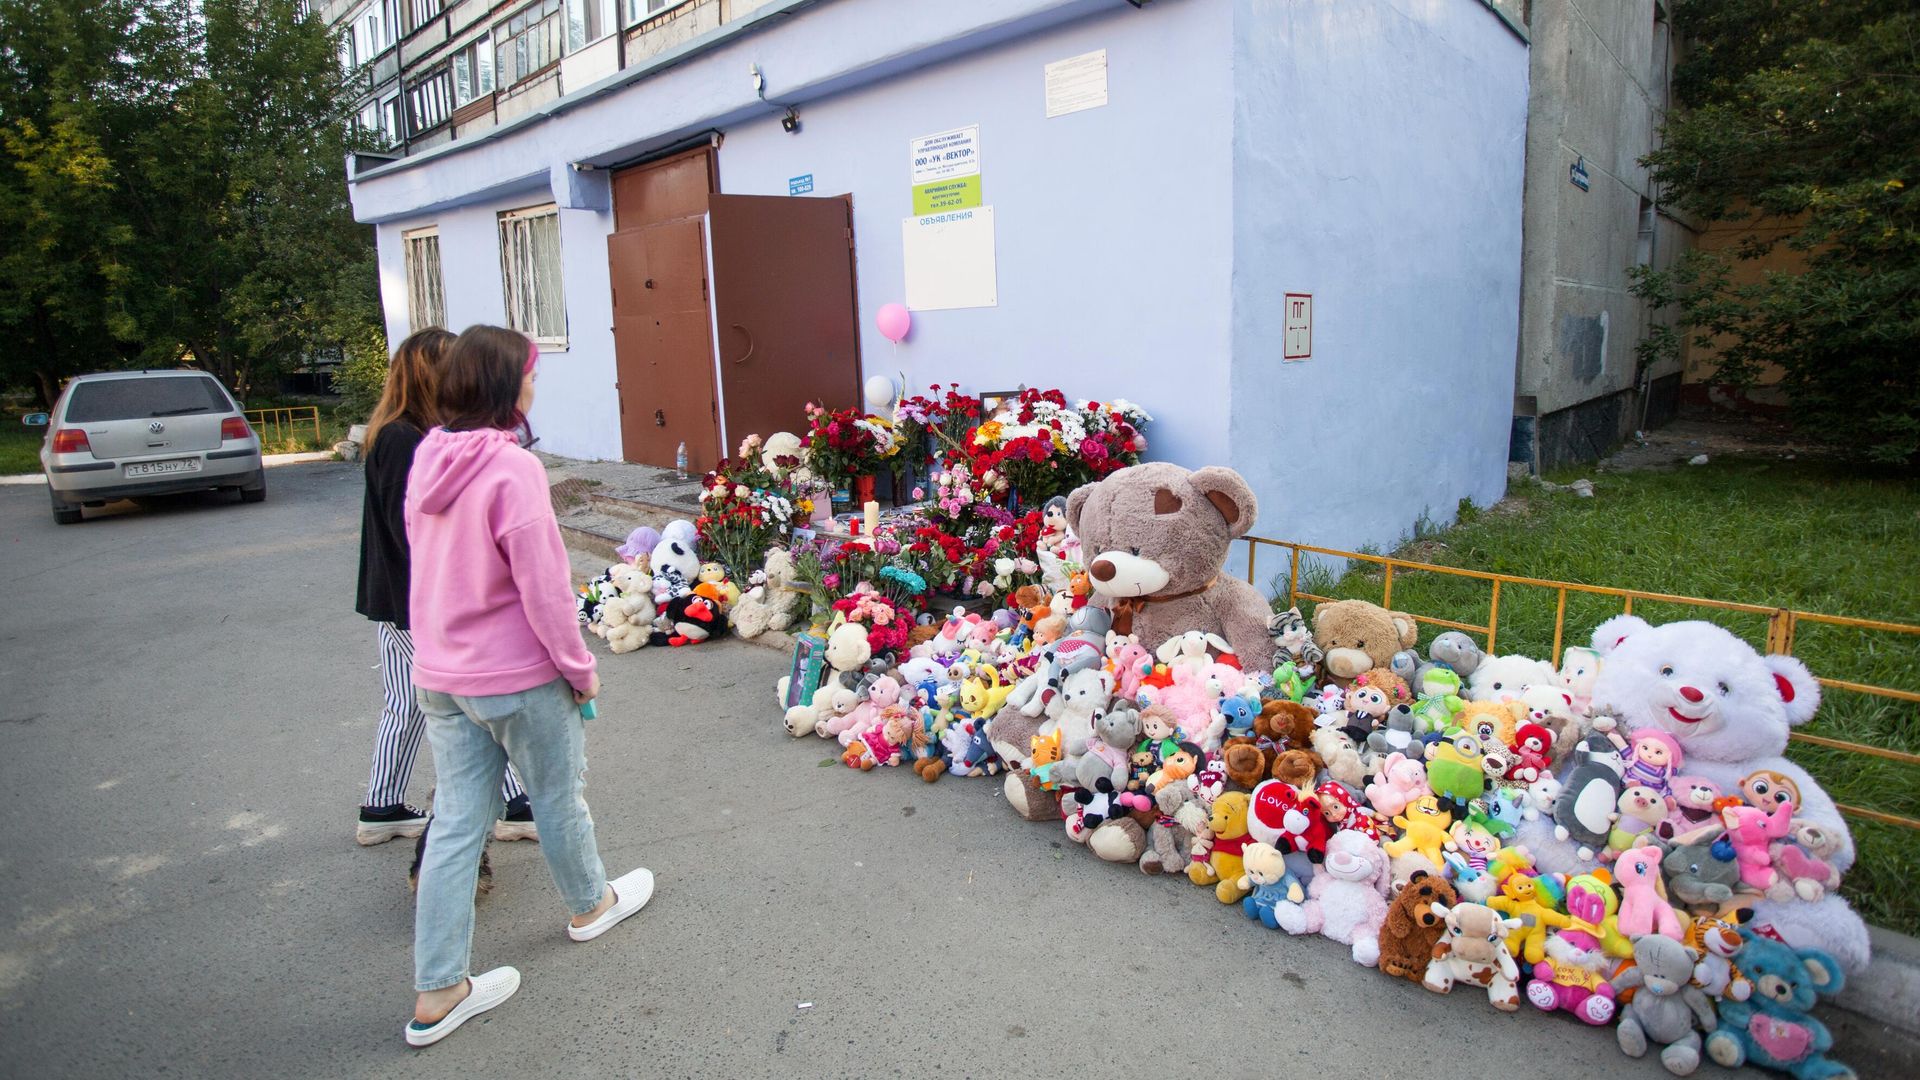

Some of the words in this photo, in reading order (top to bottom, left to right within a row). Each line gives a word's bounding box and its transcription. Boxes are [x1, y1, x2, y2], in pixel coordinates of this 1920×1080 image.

[915, 157, 927, 166] ООО
[943, 148, 974, 160] «ВЕКТОР»
[925, 185, 948, 194] АВАРИЙНАЯ
[920, 211, 973, 226] ОБЪЯВЛЕНИЯ
[1293, 302, 1304, 318] ПГ
[1260, 791, 1289, 811] Love
